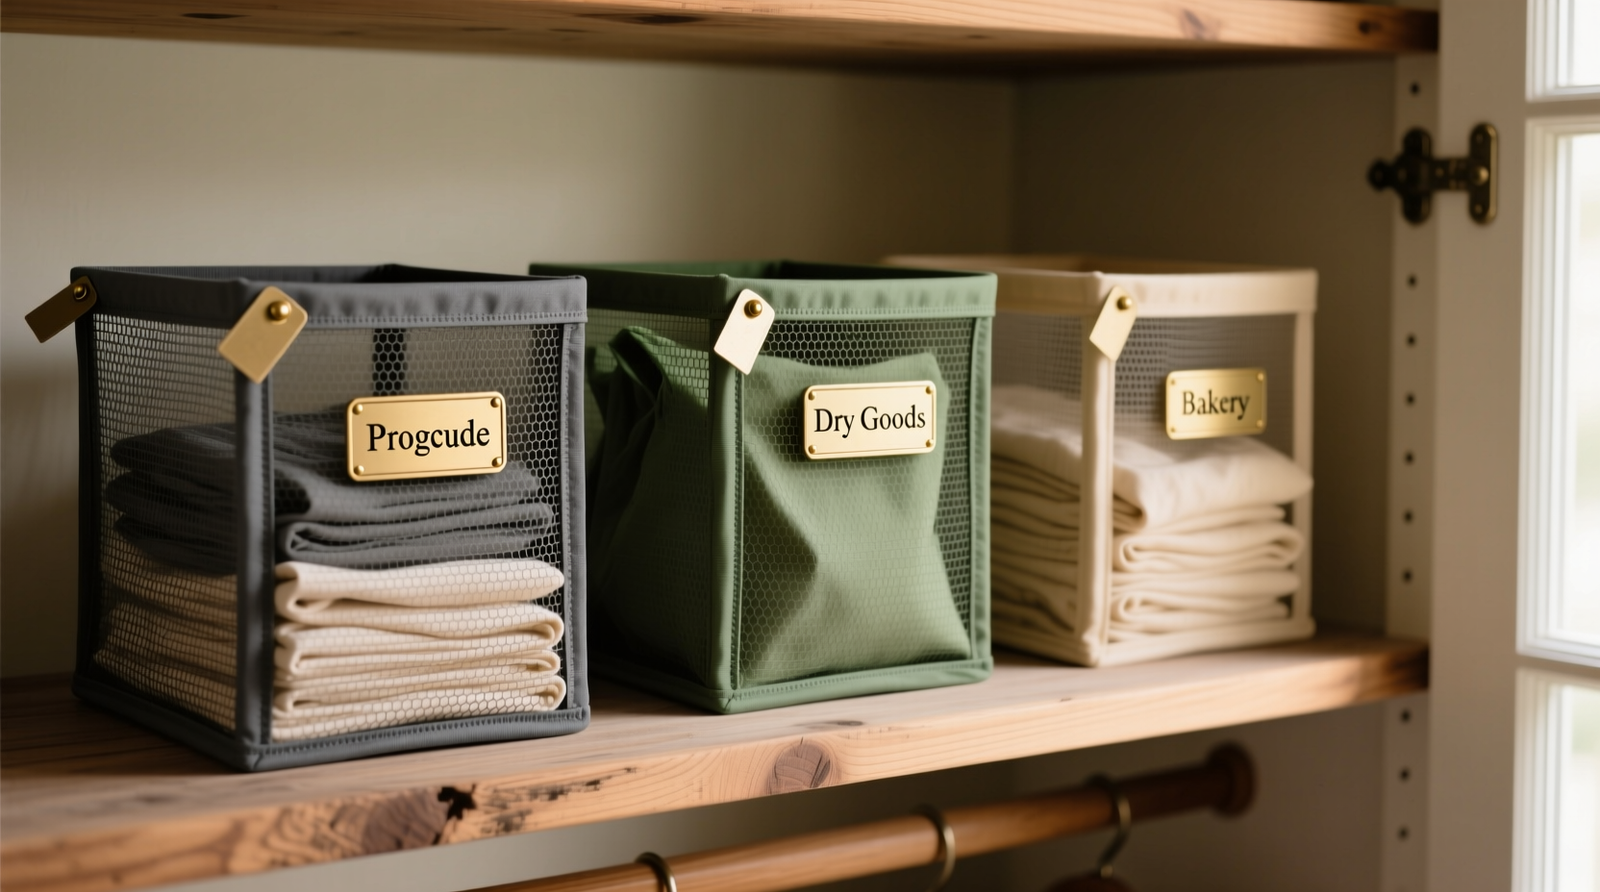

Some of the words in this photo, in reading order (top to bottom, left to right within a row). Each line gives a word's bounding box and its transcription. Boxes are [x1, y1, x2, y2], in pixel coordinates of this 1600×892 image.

[813, 408, 855, 439] Dry
[860, 404, 926, 431] Goods
[1182, 390, 1250, 420] Bakery
[366, 418, 490, 457] Progcude
